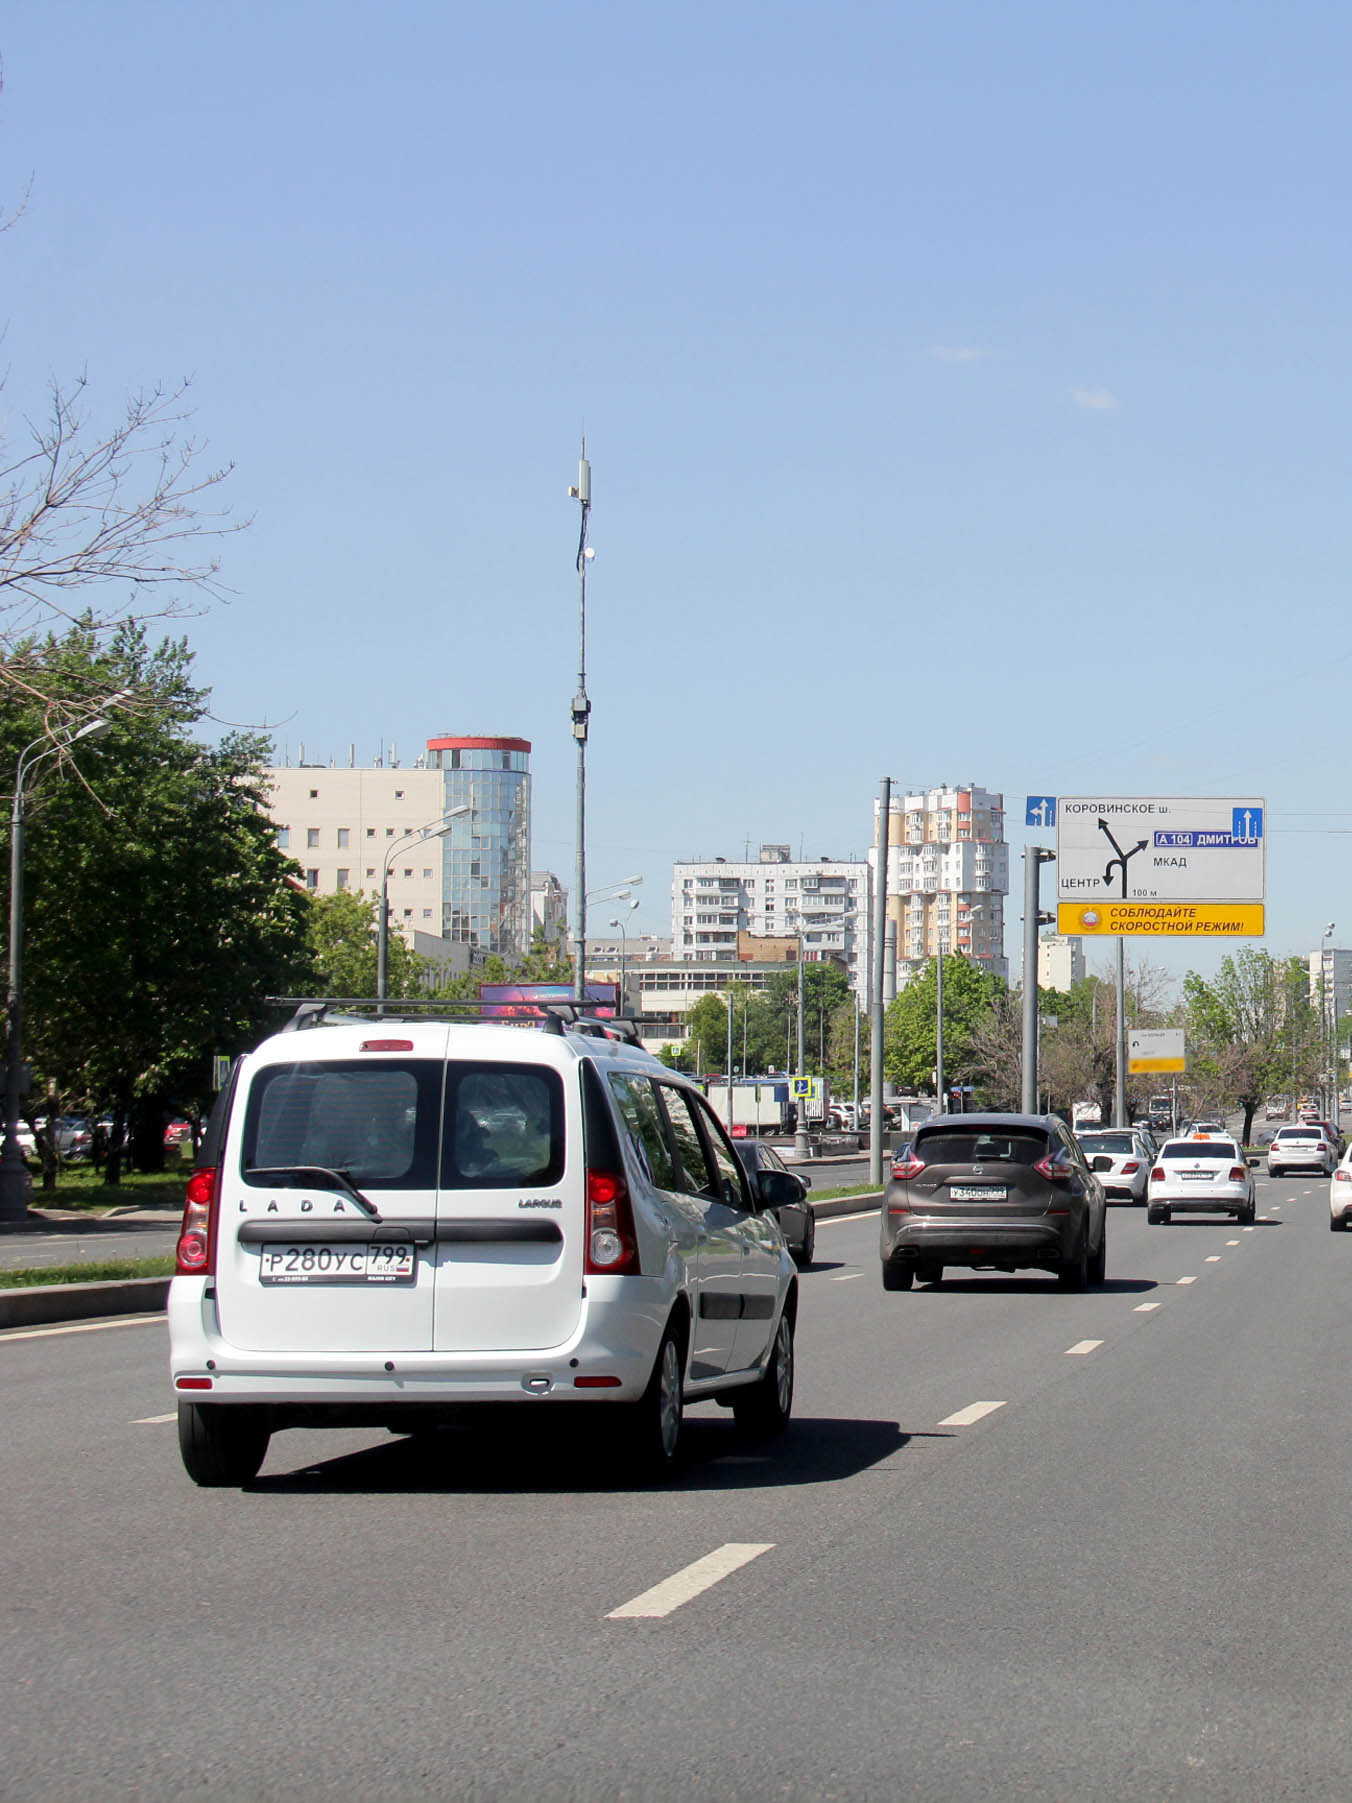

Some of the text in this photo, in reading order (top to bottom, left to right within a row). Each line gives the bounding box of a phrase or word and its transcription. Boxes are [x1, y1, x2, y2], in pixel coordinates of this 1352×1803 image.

[1065, 803, 1156, 814] КОРОВИНСКОЕ
[1170, 834, 1190, 844] 104
[1153, 857, 1187, 867] МКАД
[1061, 878, 1100, 890] ЦЕНТР
[1132, 888, 1148, 897] 100
[1110, 907, 1197, 919] СОБЛЮДАЙТЕ
[1109, 920, 1244, 932] СКОРОСТНОЙ РЕЖИМ!
[239, 1199, 345, 1212] LADA
[370, 1245, 408, 1265] 799
